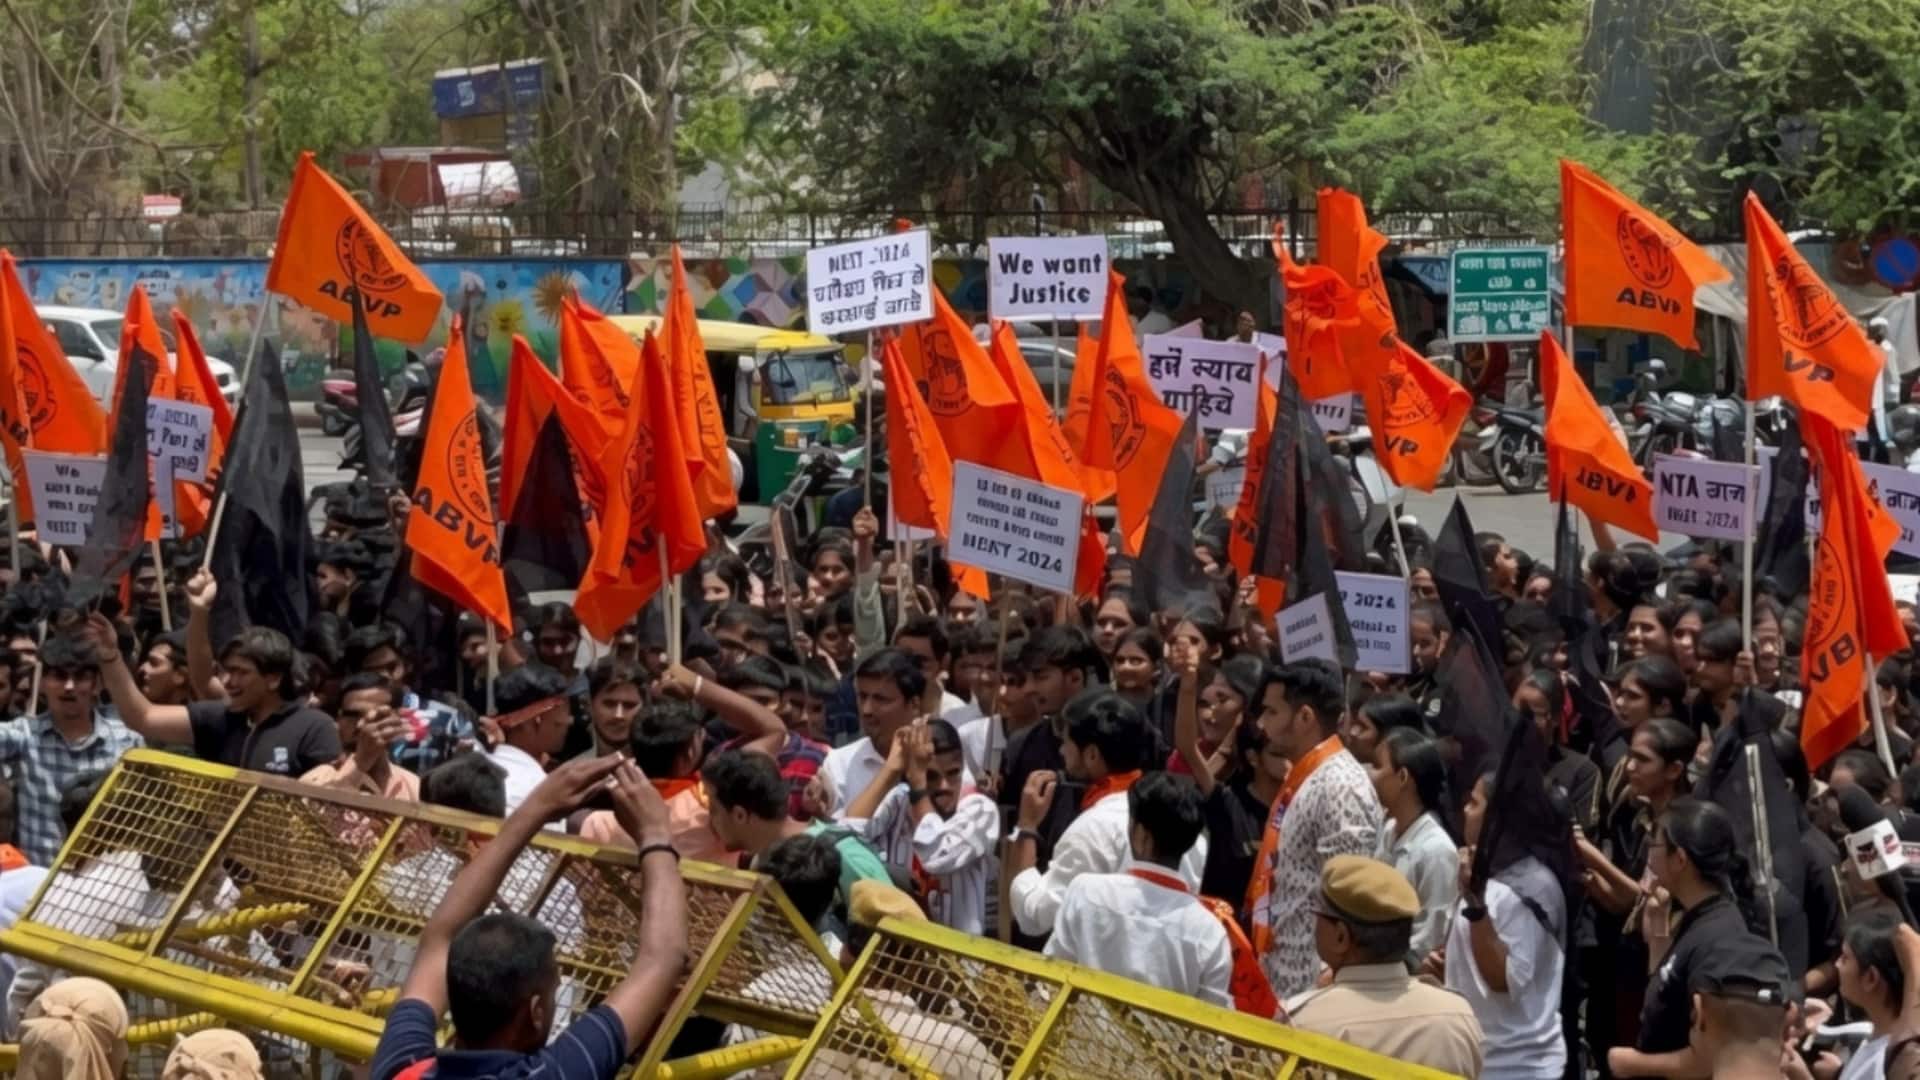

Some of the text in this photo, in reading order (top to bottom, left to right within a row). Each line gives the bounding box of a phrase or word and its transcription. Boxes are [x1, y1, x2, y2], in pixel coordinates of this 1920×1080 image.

[998, 252, 1102, 275] We want
[317, 280, 402, 318] ABVP
[1009, 281, 1090, 304] Justice
[1616, 287, 1681, 316] ABVP
[1783, 350, 1835, 382] VP
[1660, 471, 1699, 499] NTA
